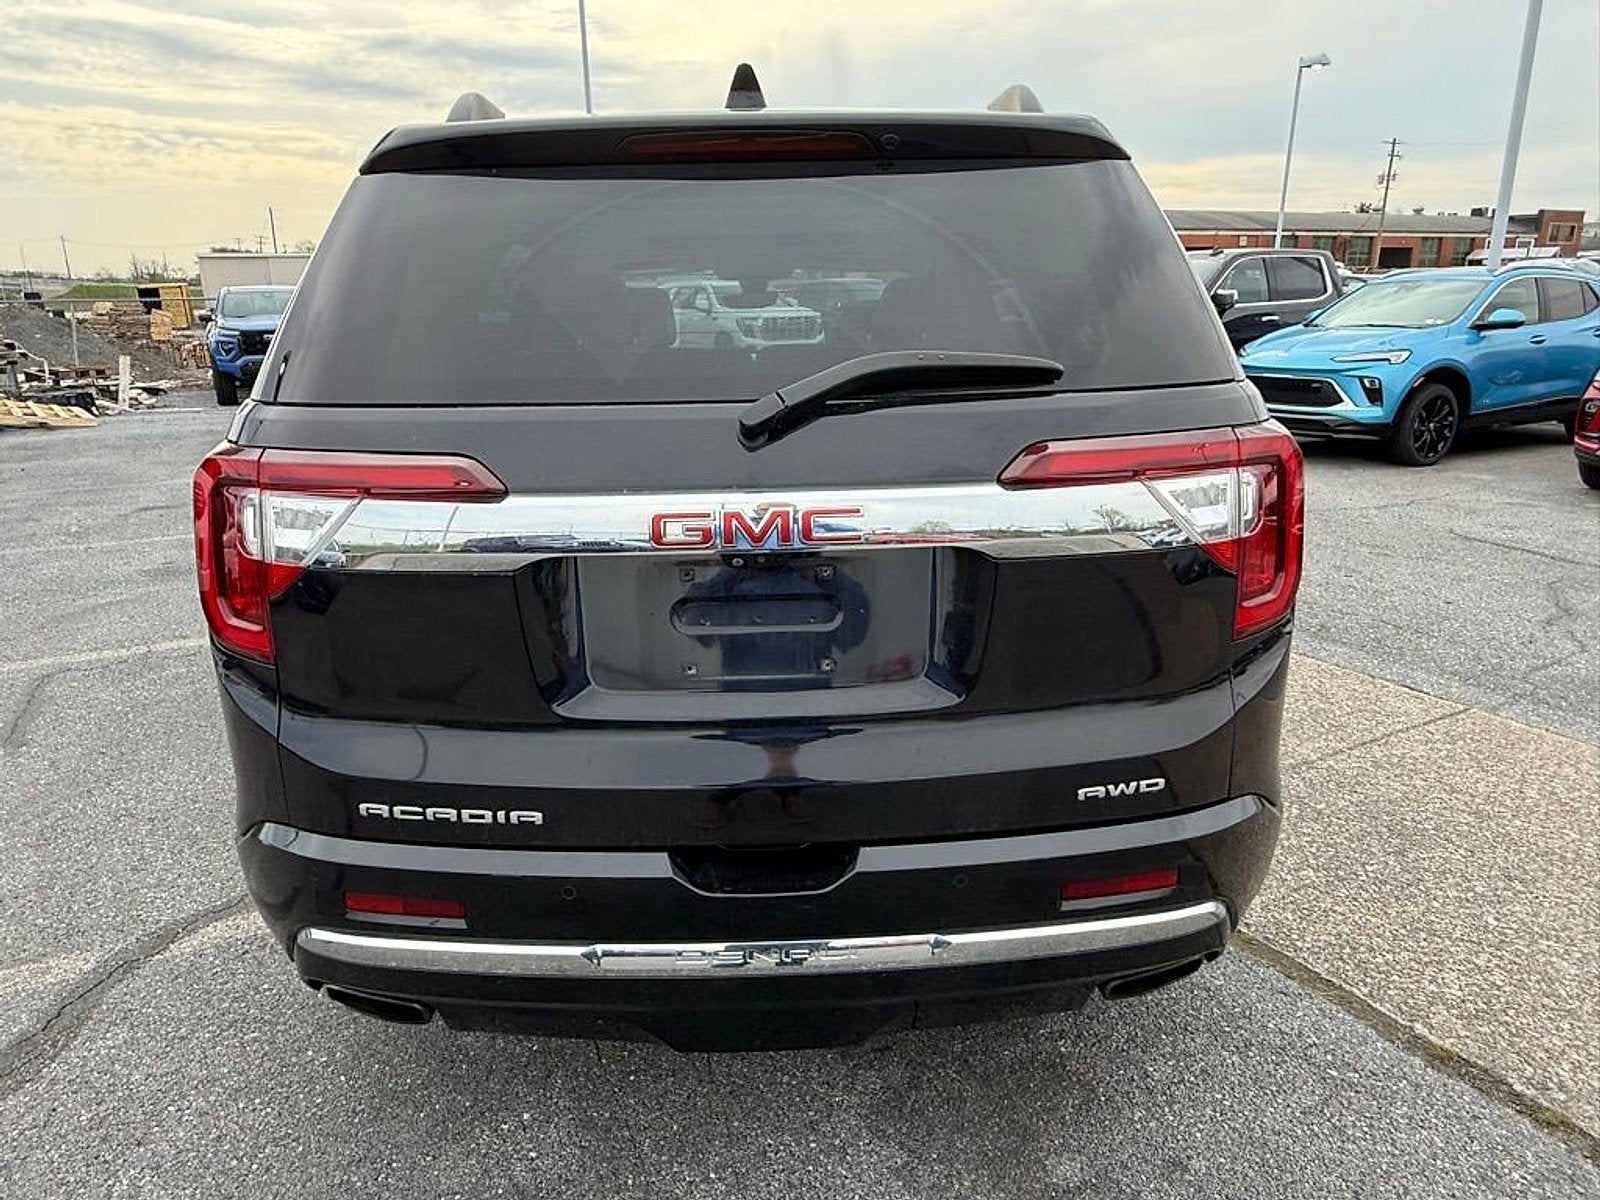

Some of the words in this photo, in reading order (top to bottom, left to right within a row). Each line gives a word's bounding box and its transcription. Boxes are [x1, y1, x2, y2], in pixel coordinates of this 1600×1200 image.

[649, 504, 864, 548] GMC
[1077, 777, 1166, 801] AWD
[358, 803, 544, 825] ACADIA
